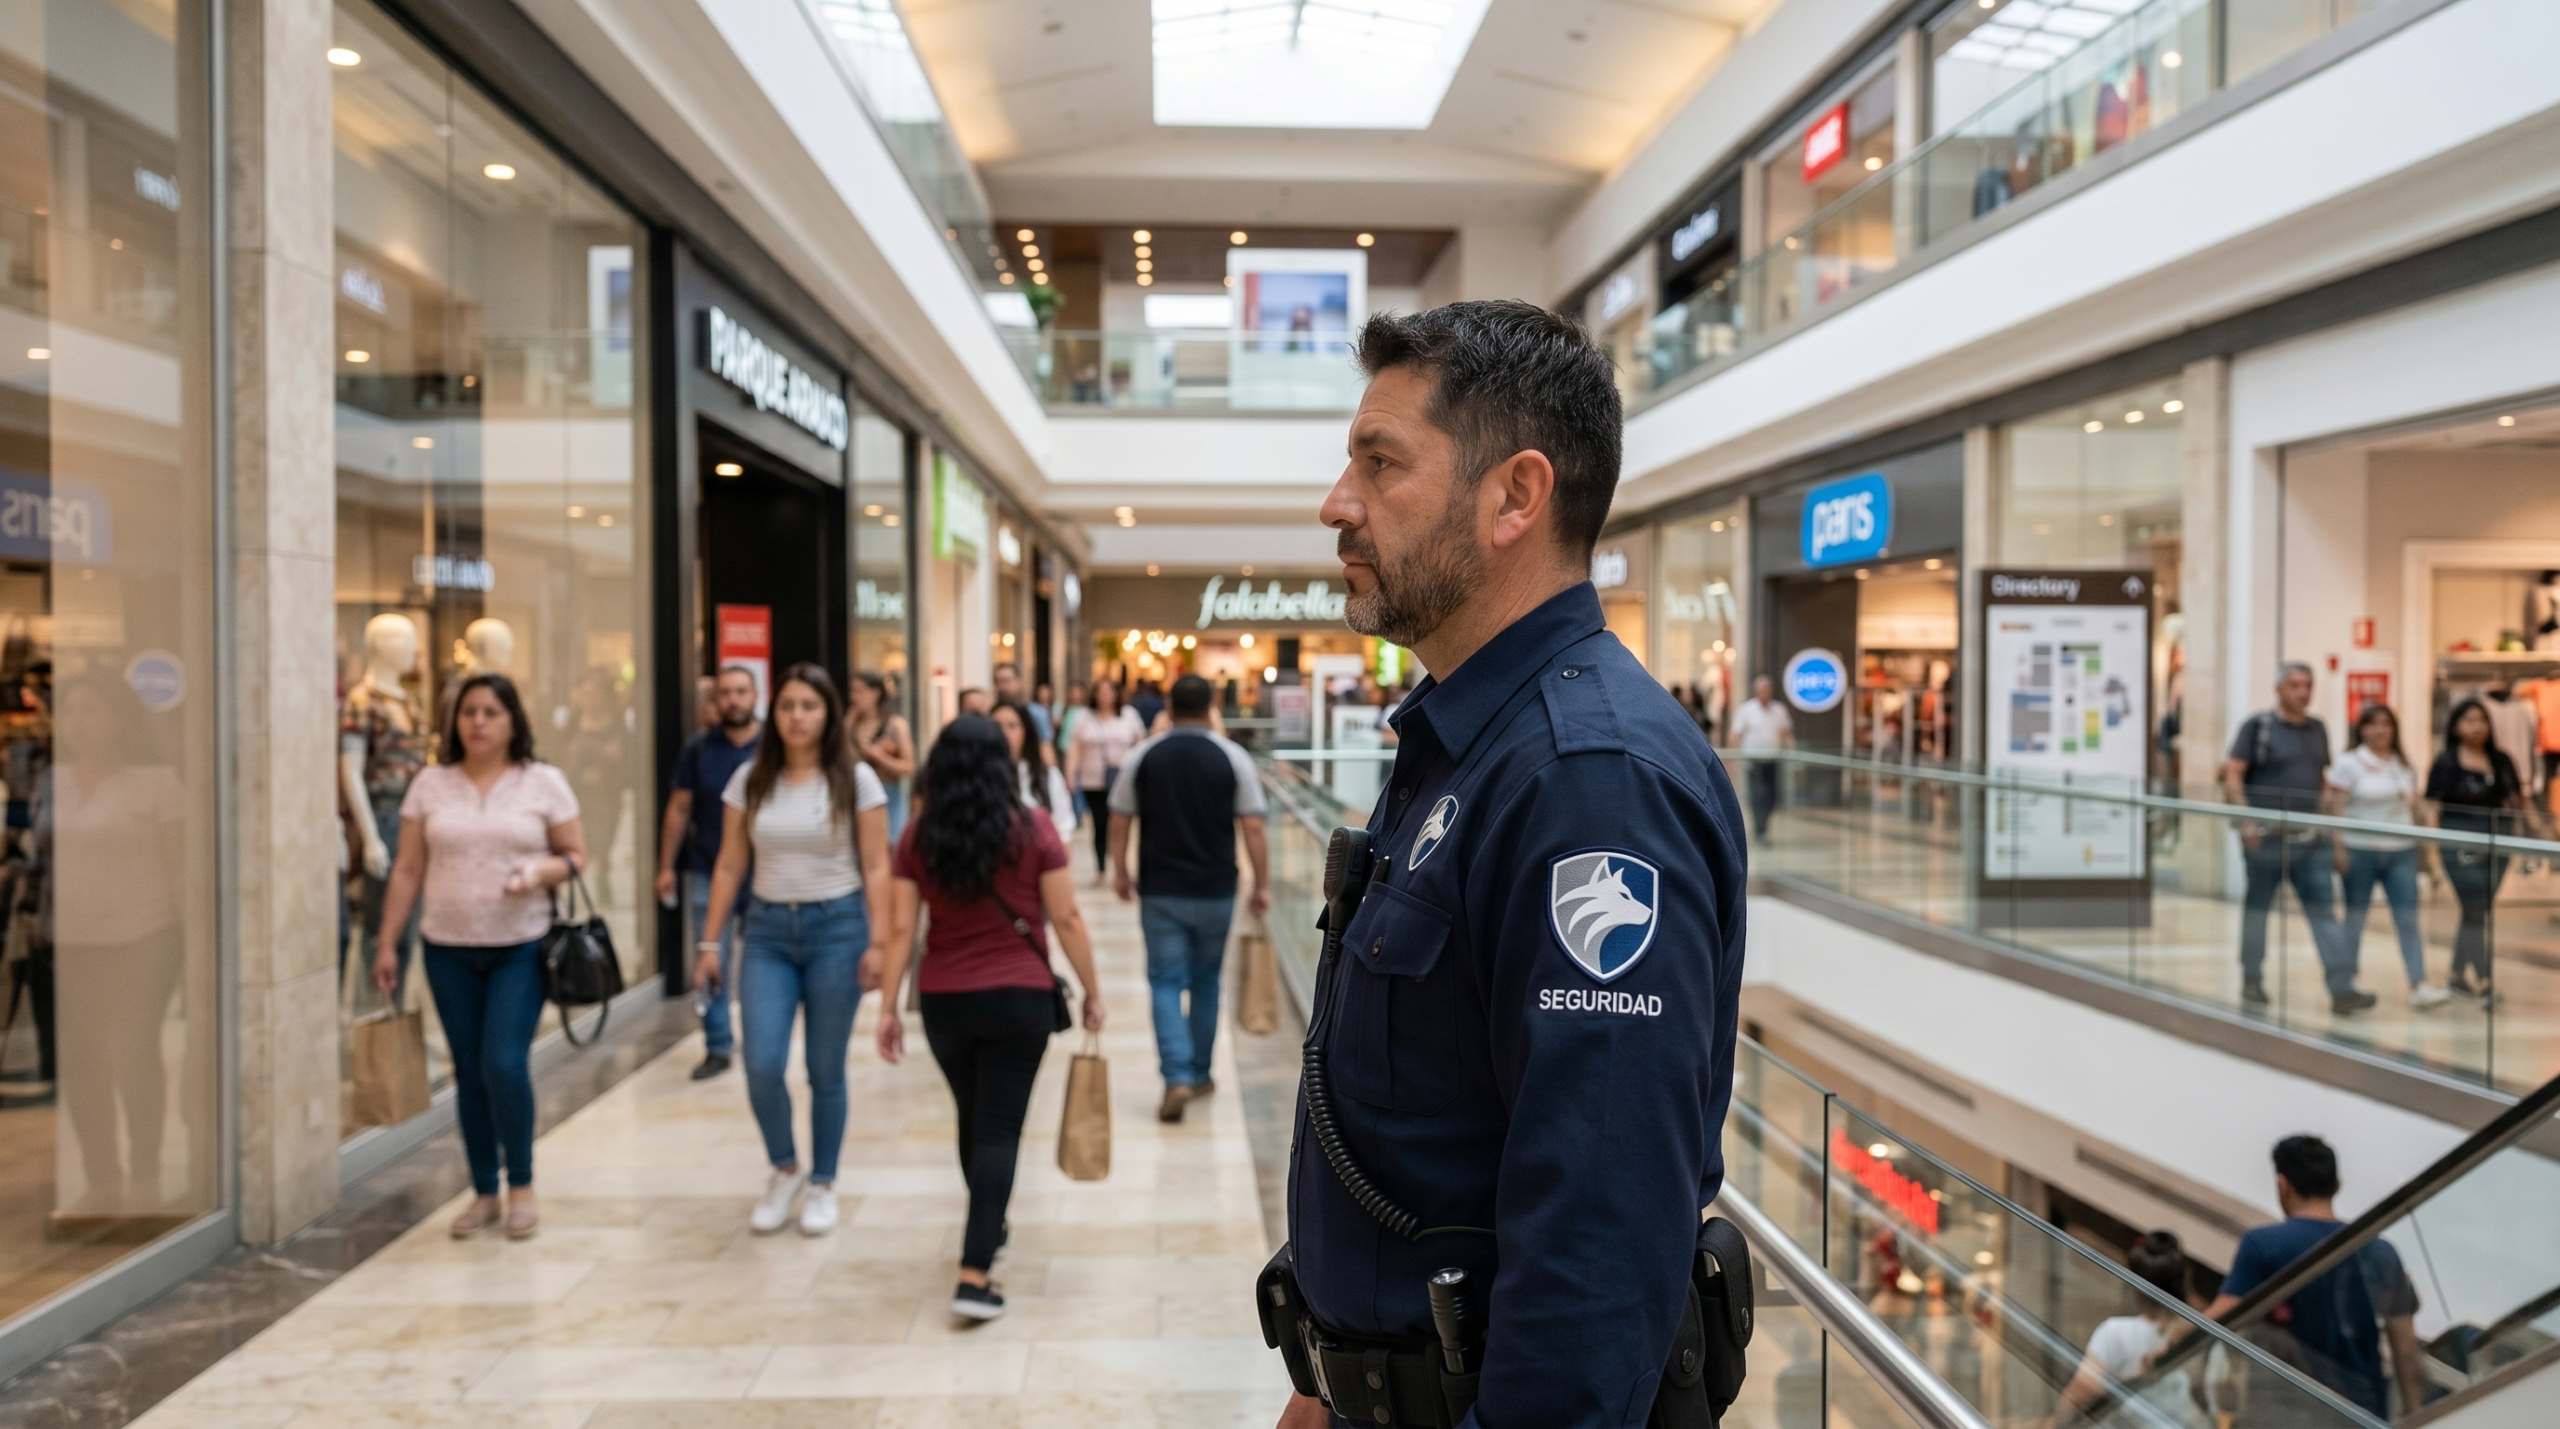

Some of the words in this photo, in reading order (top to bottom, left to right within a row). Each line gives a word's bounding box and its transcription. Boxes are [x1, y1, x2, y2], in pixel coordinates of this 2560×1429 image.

[709, 305, 789, 413] PARQUE
[1195, 574, 1347, 630] falabella
[1991, 574, 2081, 602] Directory
[1539, 989, 1663, 1017] SEGURIDAD
